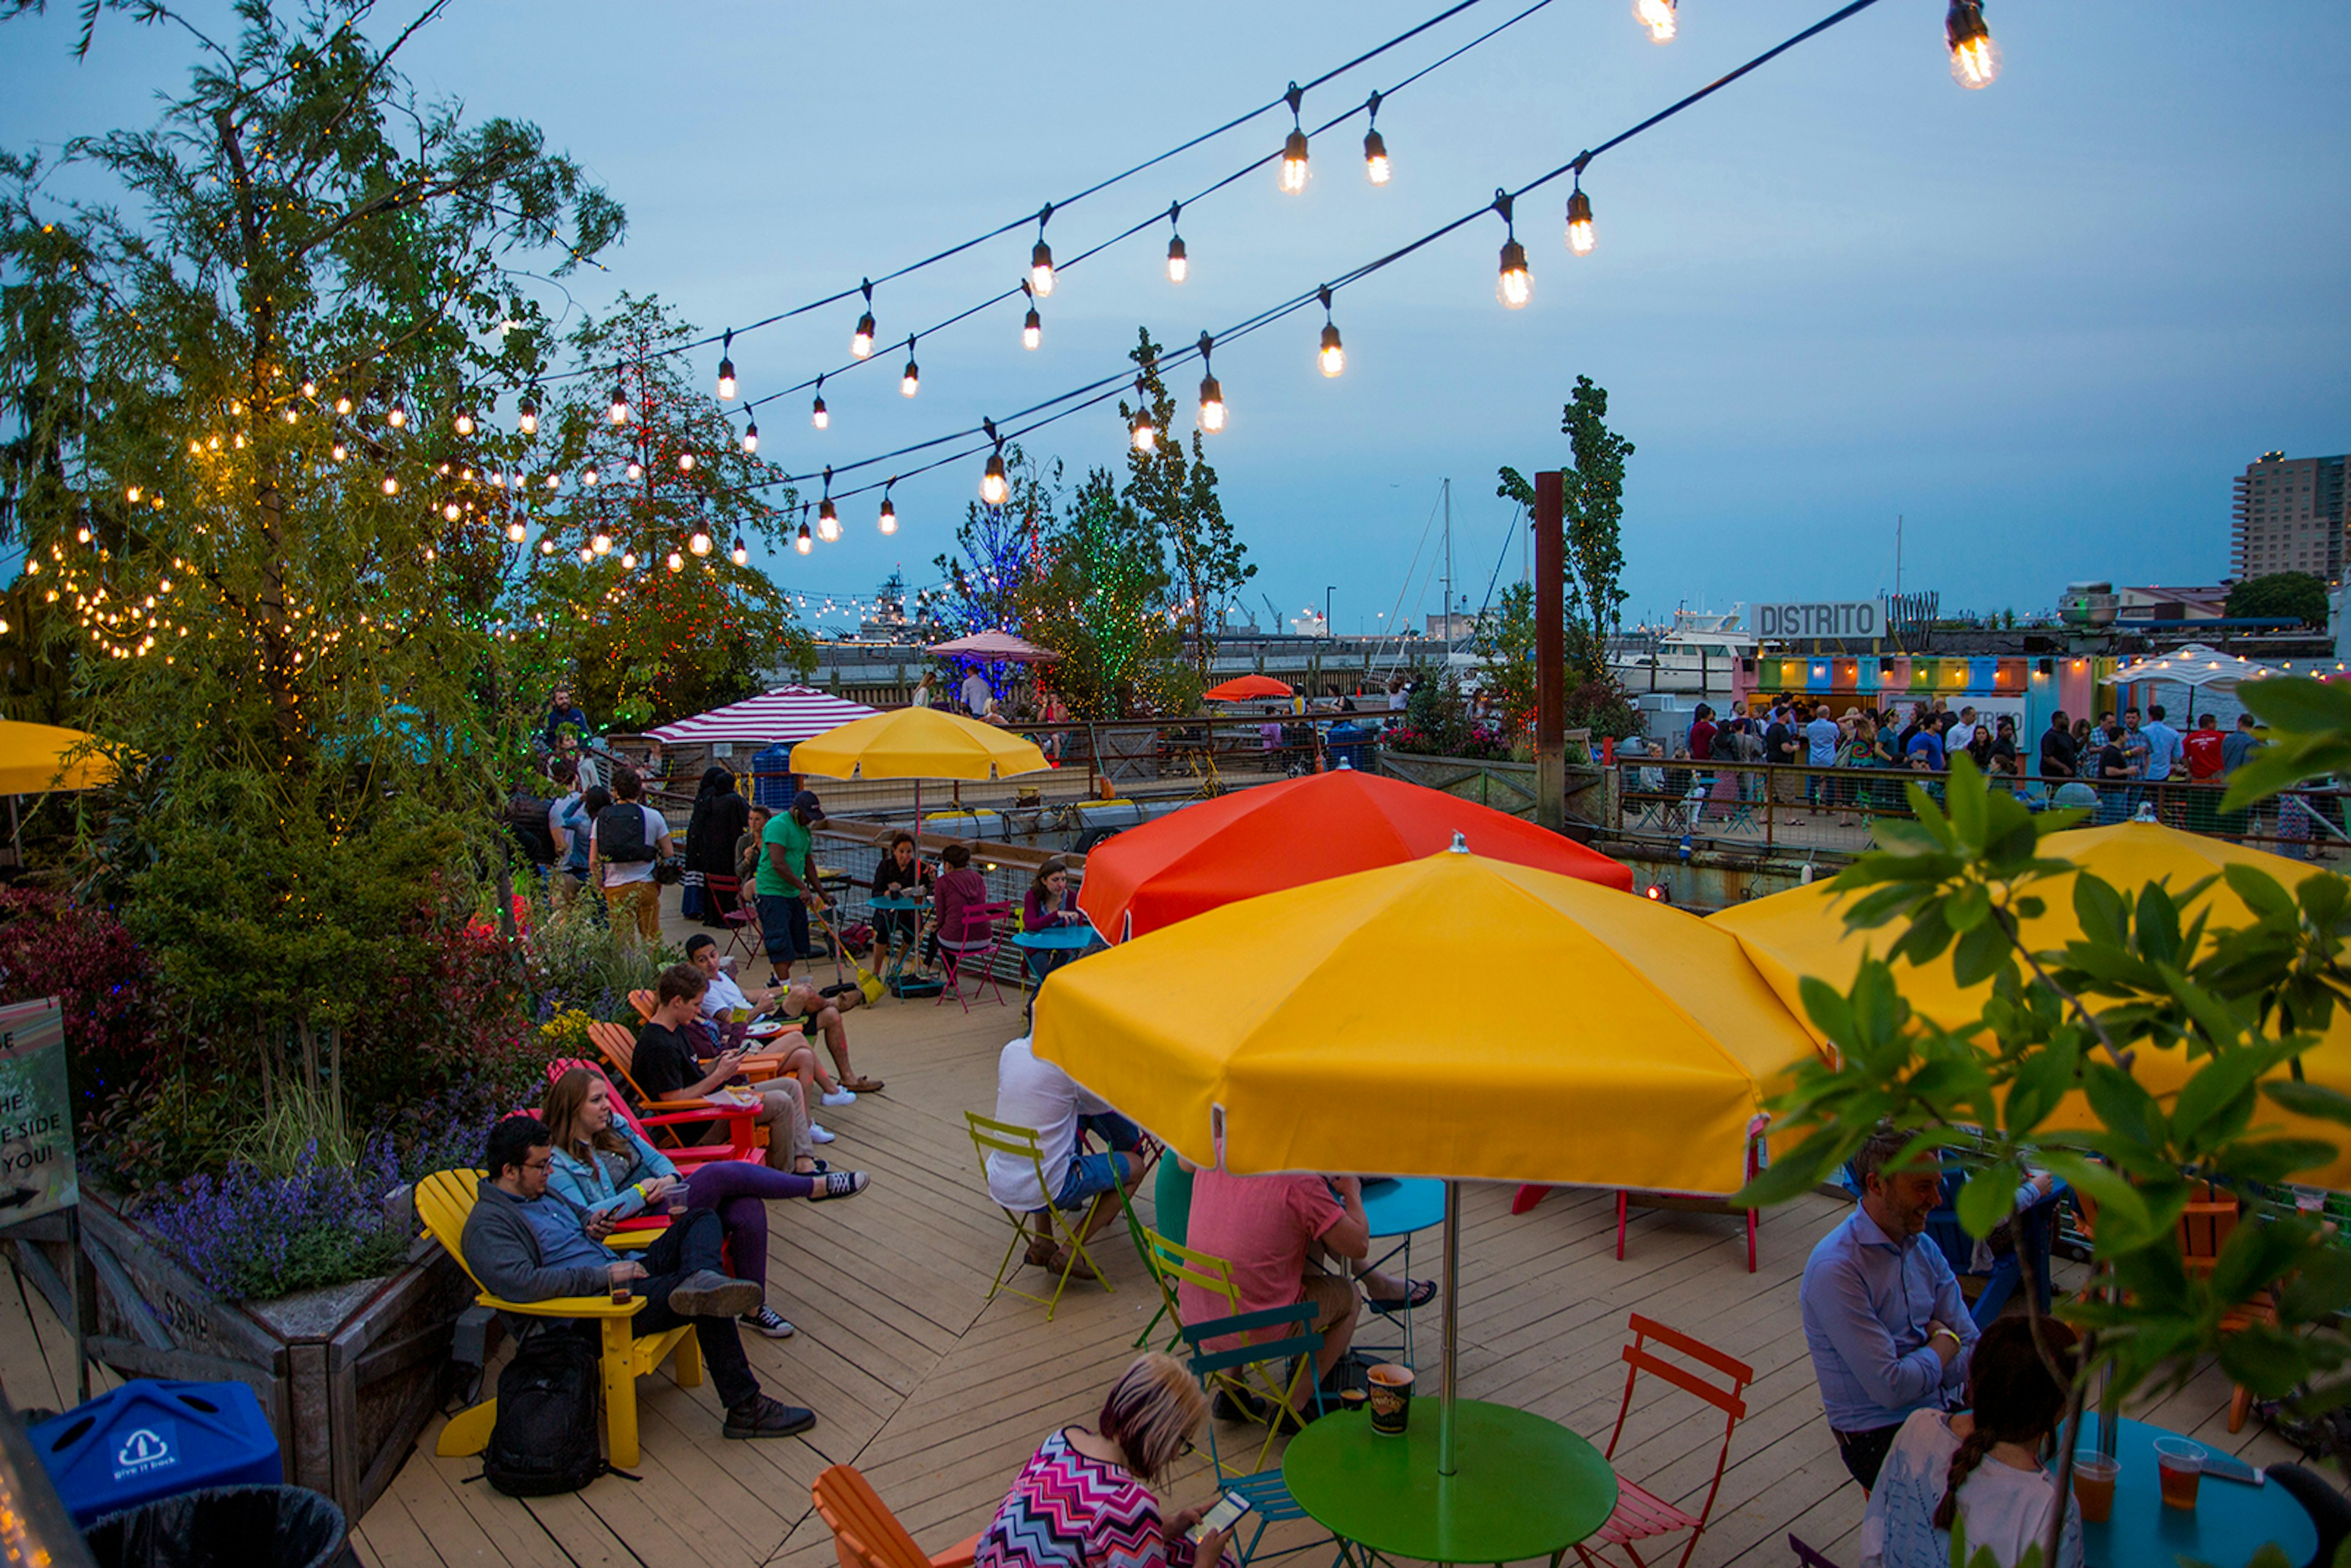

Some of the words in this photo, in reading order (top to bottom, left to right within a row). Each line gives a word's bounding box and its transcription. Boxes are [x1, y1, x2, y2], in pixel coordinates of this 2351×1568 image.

[1760, 604, 1874, 636] DISTRITO
[18, 1113, 60, 1139] SIDE
[4, 1145, 53, 1172] YOU!
